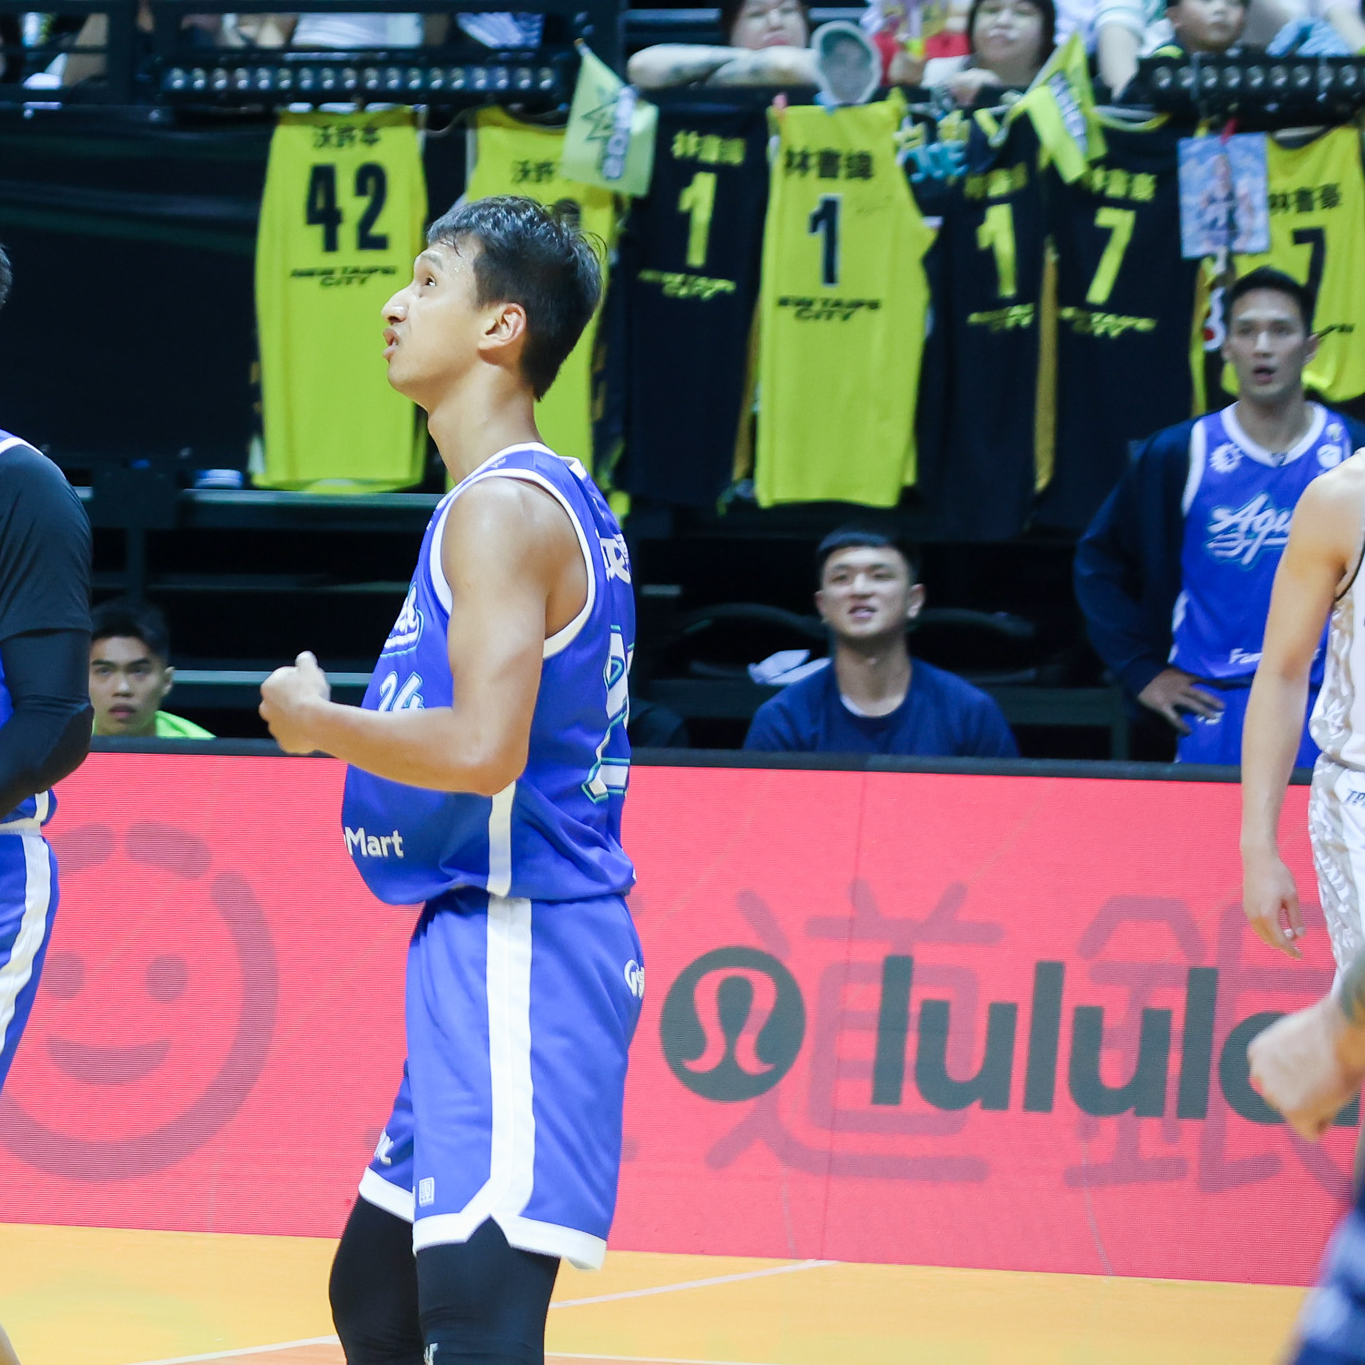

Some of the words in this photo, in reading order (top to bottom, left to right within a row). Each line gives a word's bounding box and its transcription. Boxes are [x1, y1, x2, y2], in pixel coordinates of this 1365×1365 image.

[306, 163, 389, 252] 42
[677, 171, 717, 267] 1
[807, 193, 843, 289] 1
[976, 203, 1017, 297] 1
[1085, 207, 1137, 305] 7
[1292, 226, 1327, 299] 7
[343, 826, 405, 858] Mart
